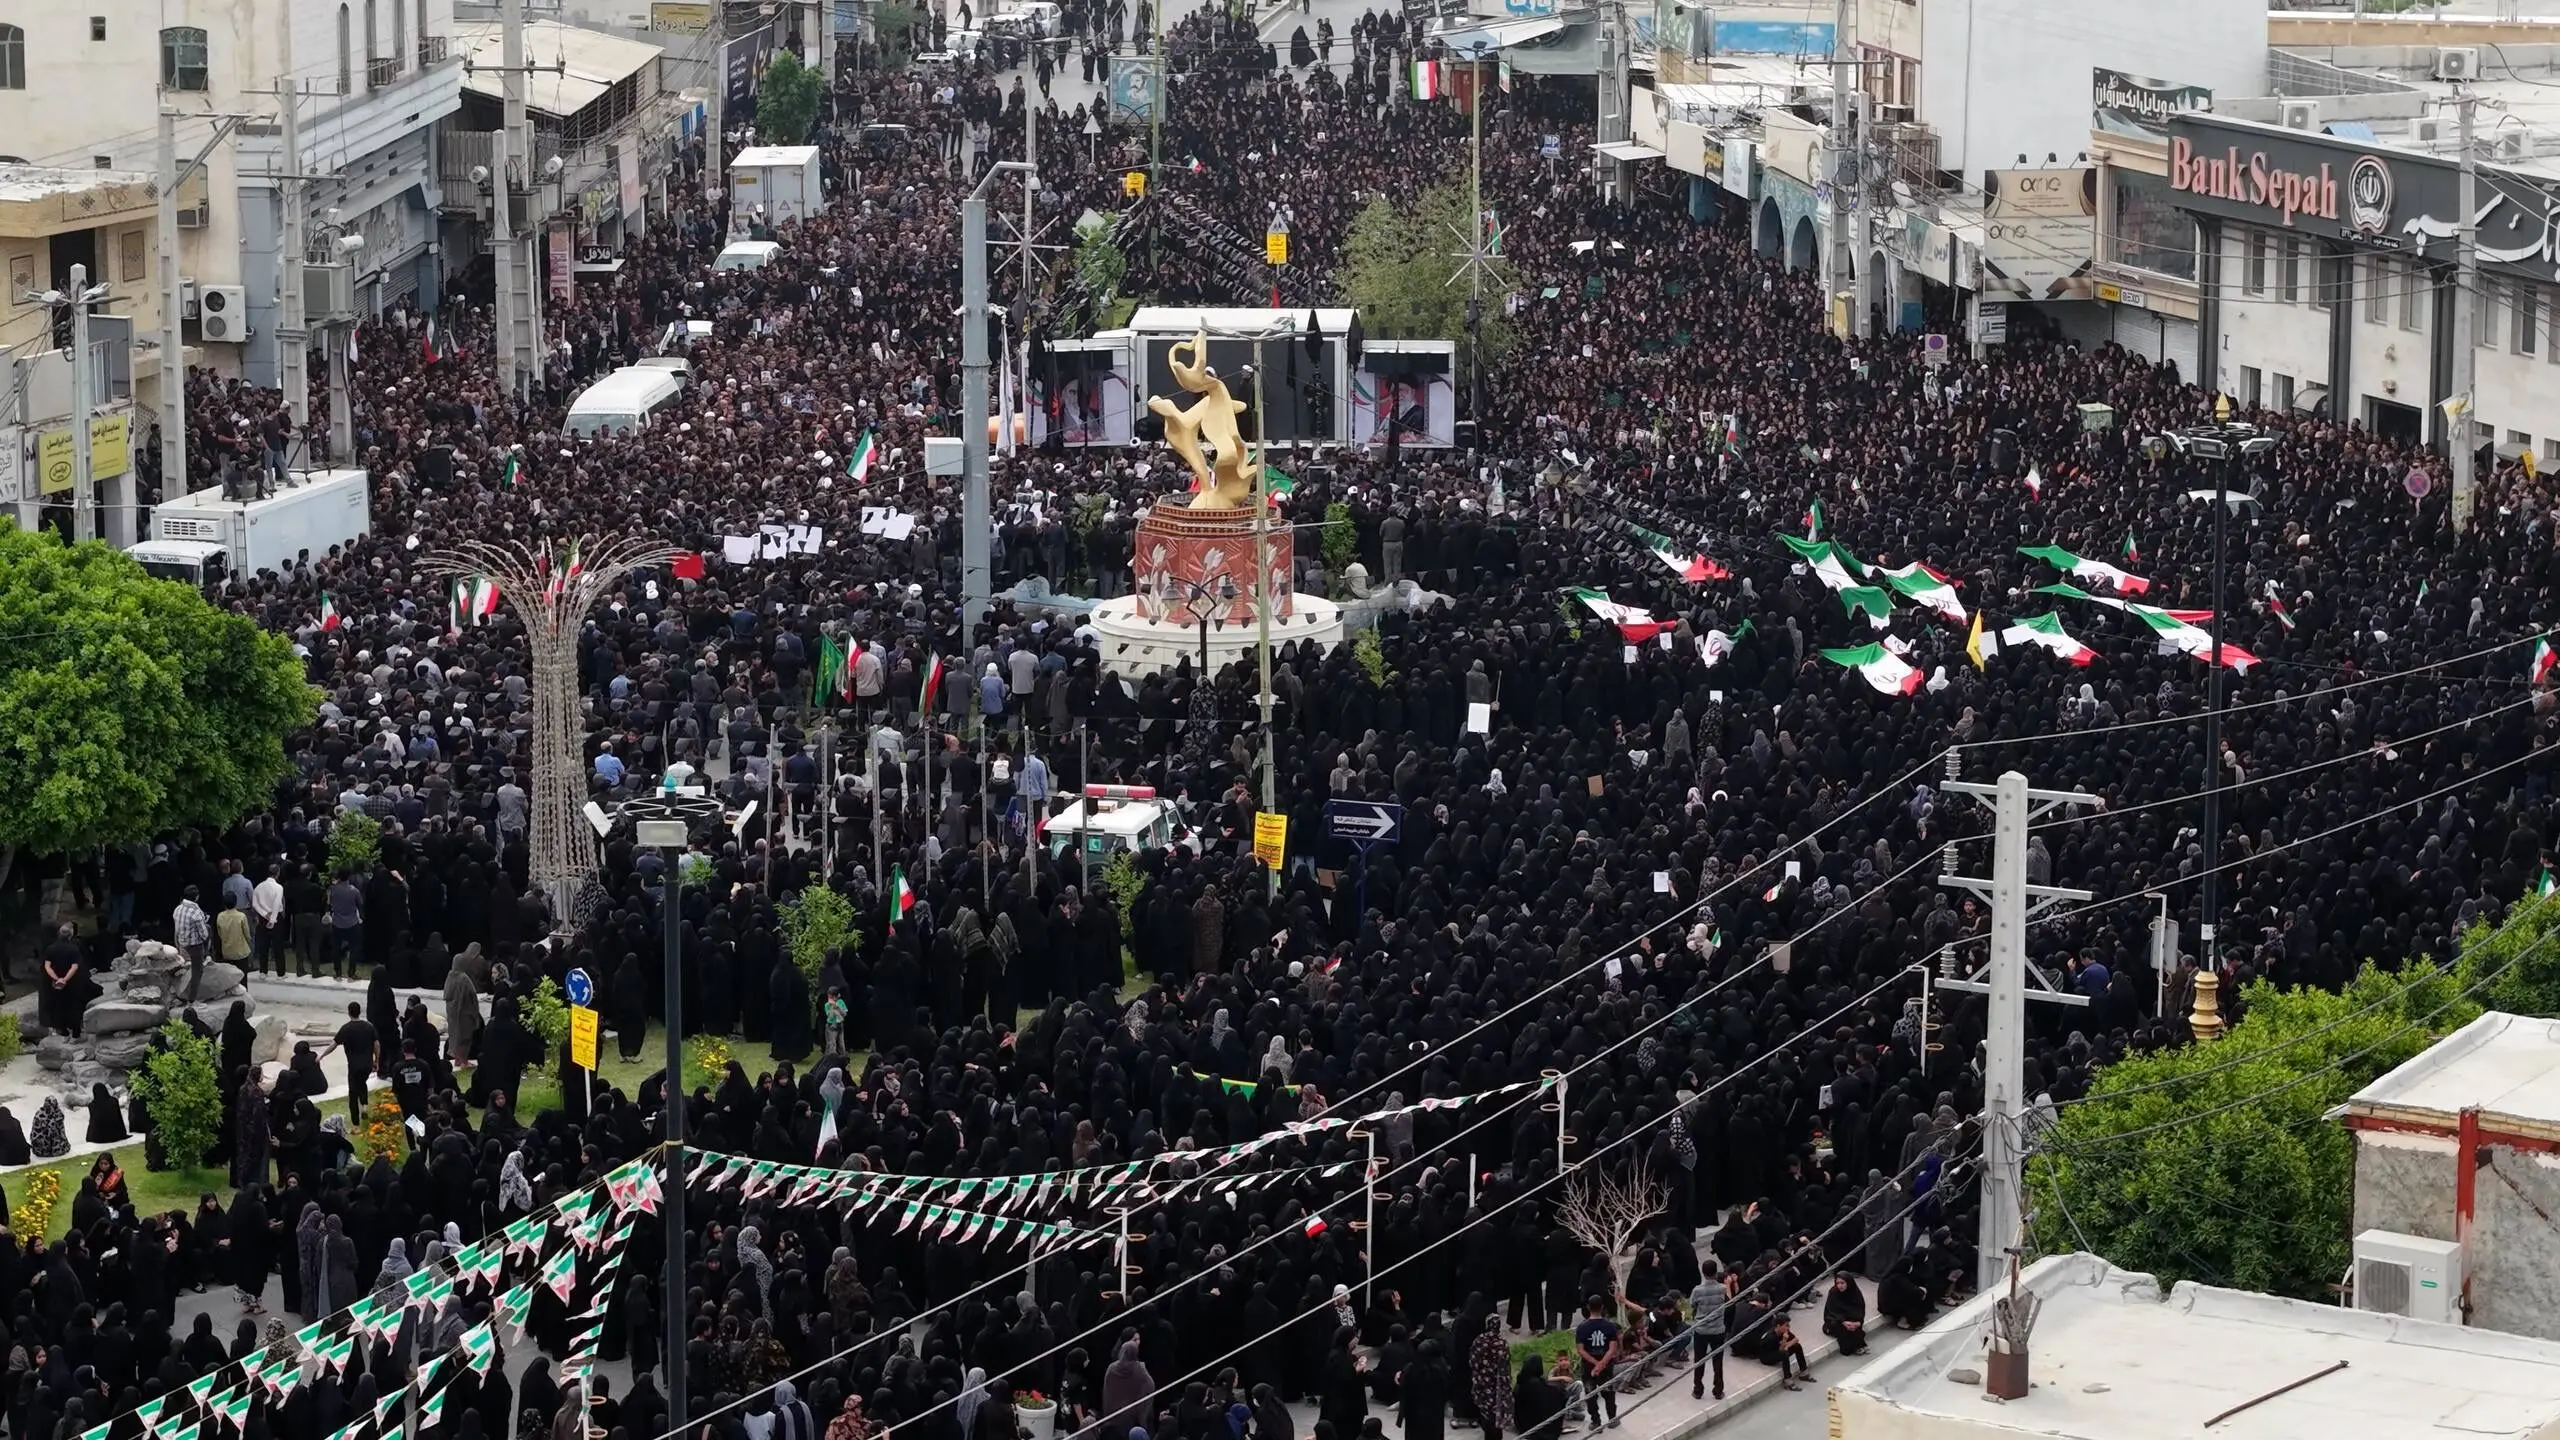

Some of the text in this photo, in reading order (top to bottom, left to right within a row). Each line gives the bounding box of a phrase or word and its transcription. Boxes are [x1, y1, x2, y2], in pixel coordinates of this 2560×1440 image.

[2171, 136, 2339, 227] Bank Sepah
[584, 247, 611, 262] فلافل
